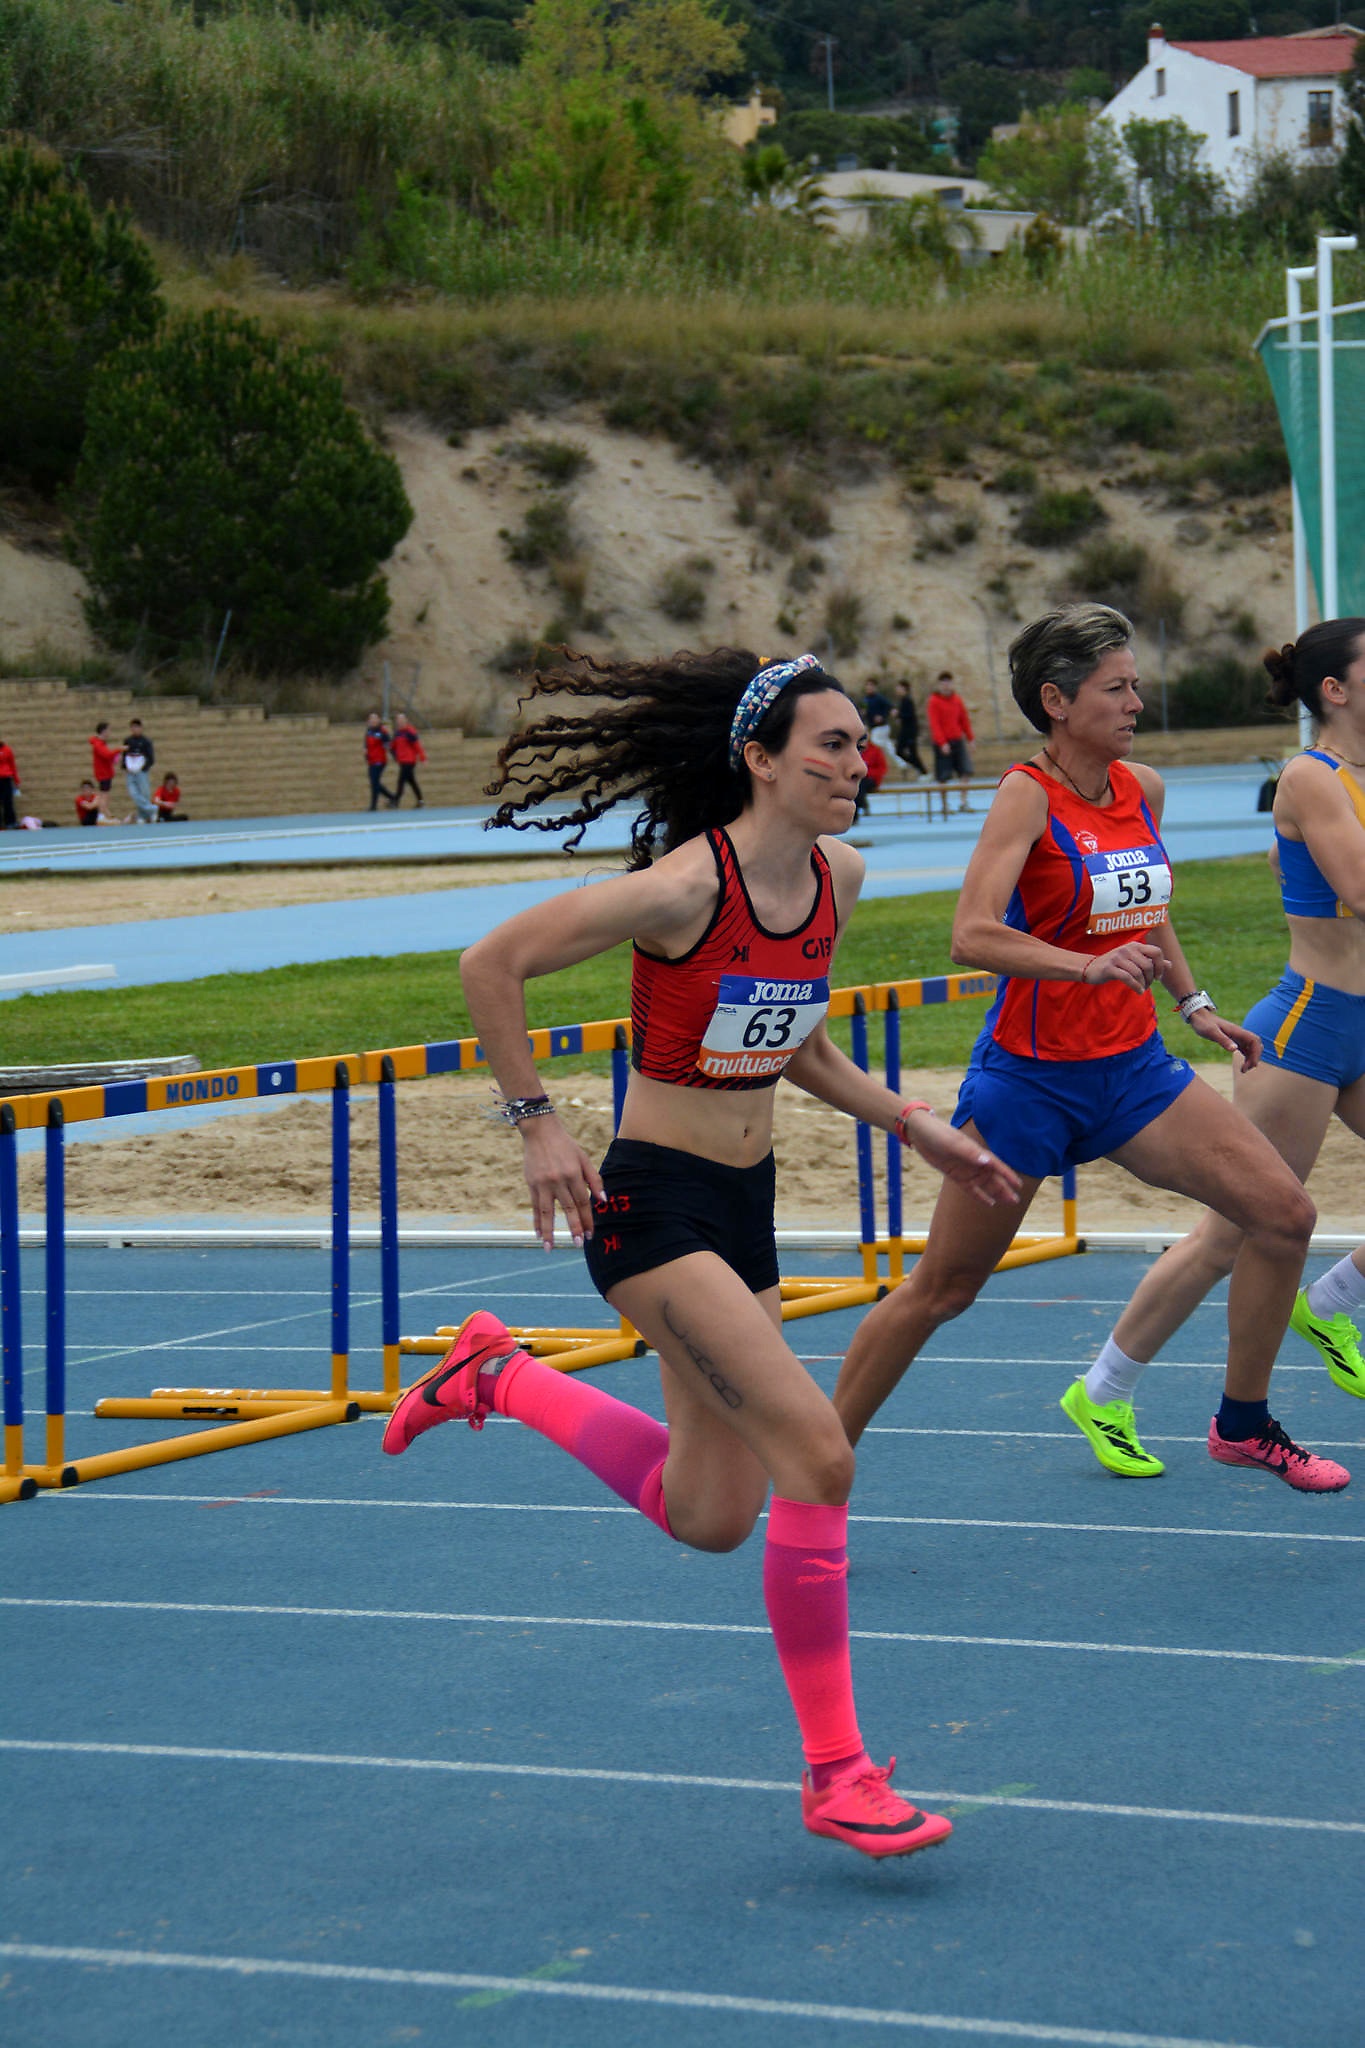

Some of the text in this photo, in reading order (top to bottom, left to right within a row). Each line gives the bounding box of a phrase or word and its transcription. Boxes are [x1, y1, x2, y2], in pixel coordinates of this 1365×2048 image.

[1117, 869, 1151, 908] 53
[1095, 906, 1166, 932] mutuacat
[742, 1007, 797, 1049] 63
[166, 1075, 240, 1104] MONDO
